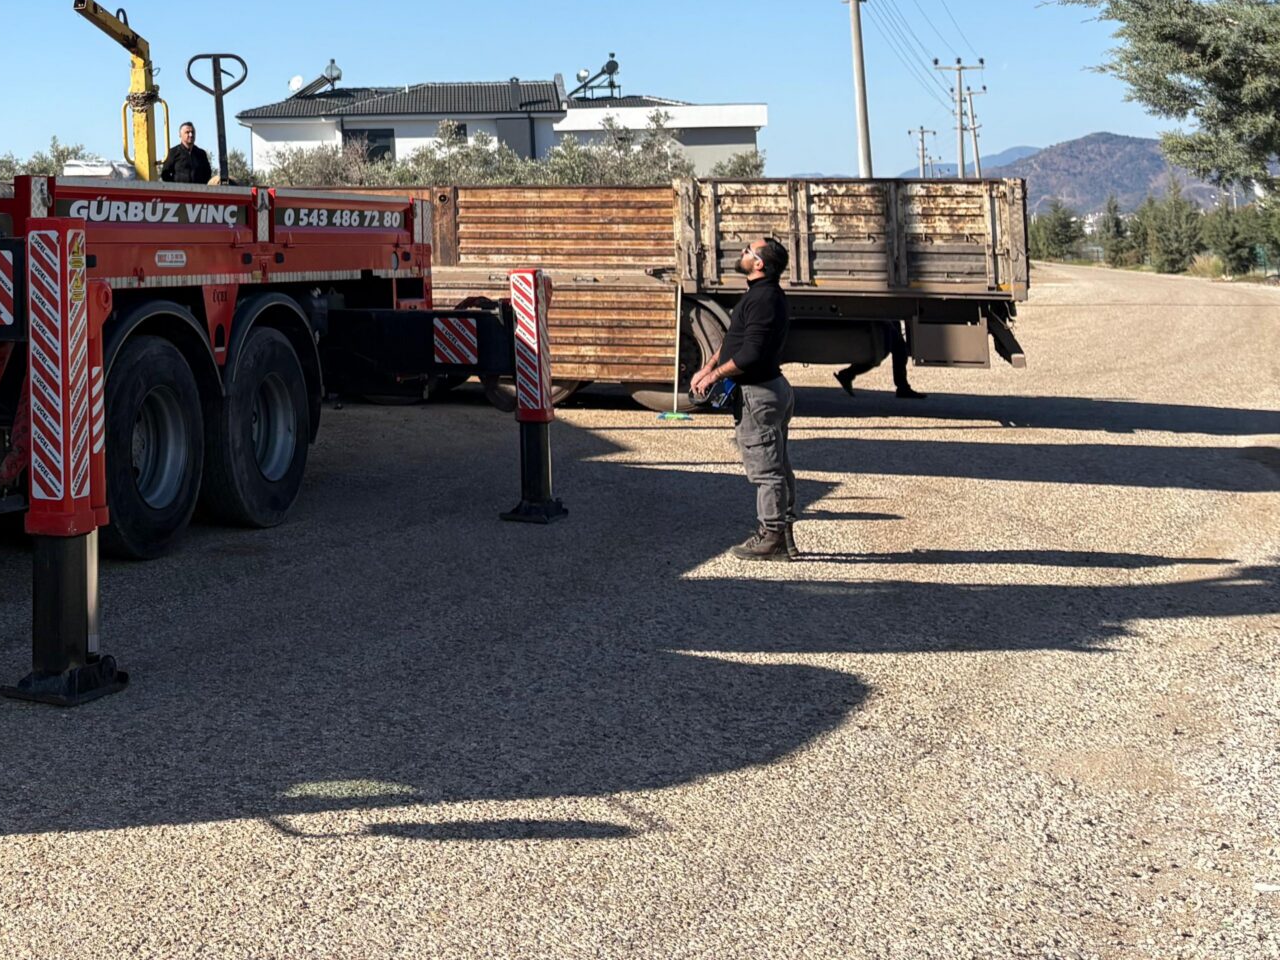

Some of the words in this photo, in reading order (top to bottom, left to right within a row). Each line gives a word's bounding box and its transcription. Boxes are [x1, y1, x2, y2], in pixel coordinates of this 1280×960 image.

[70, 196, 180, 223] GÜRBÜZ
[284, 208, 295, 227] 0
[299, 209, 328, 227] 543
[332, 210, 360, 227] 486
[363, 210, 380, 227] 72
[383, 211, 401, 228] 80
